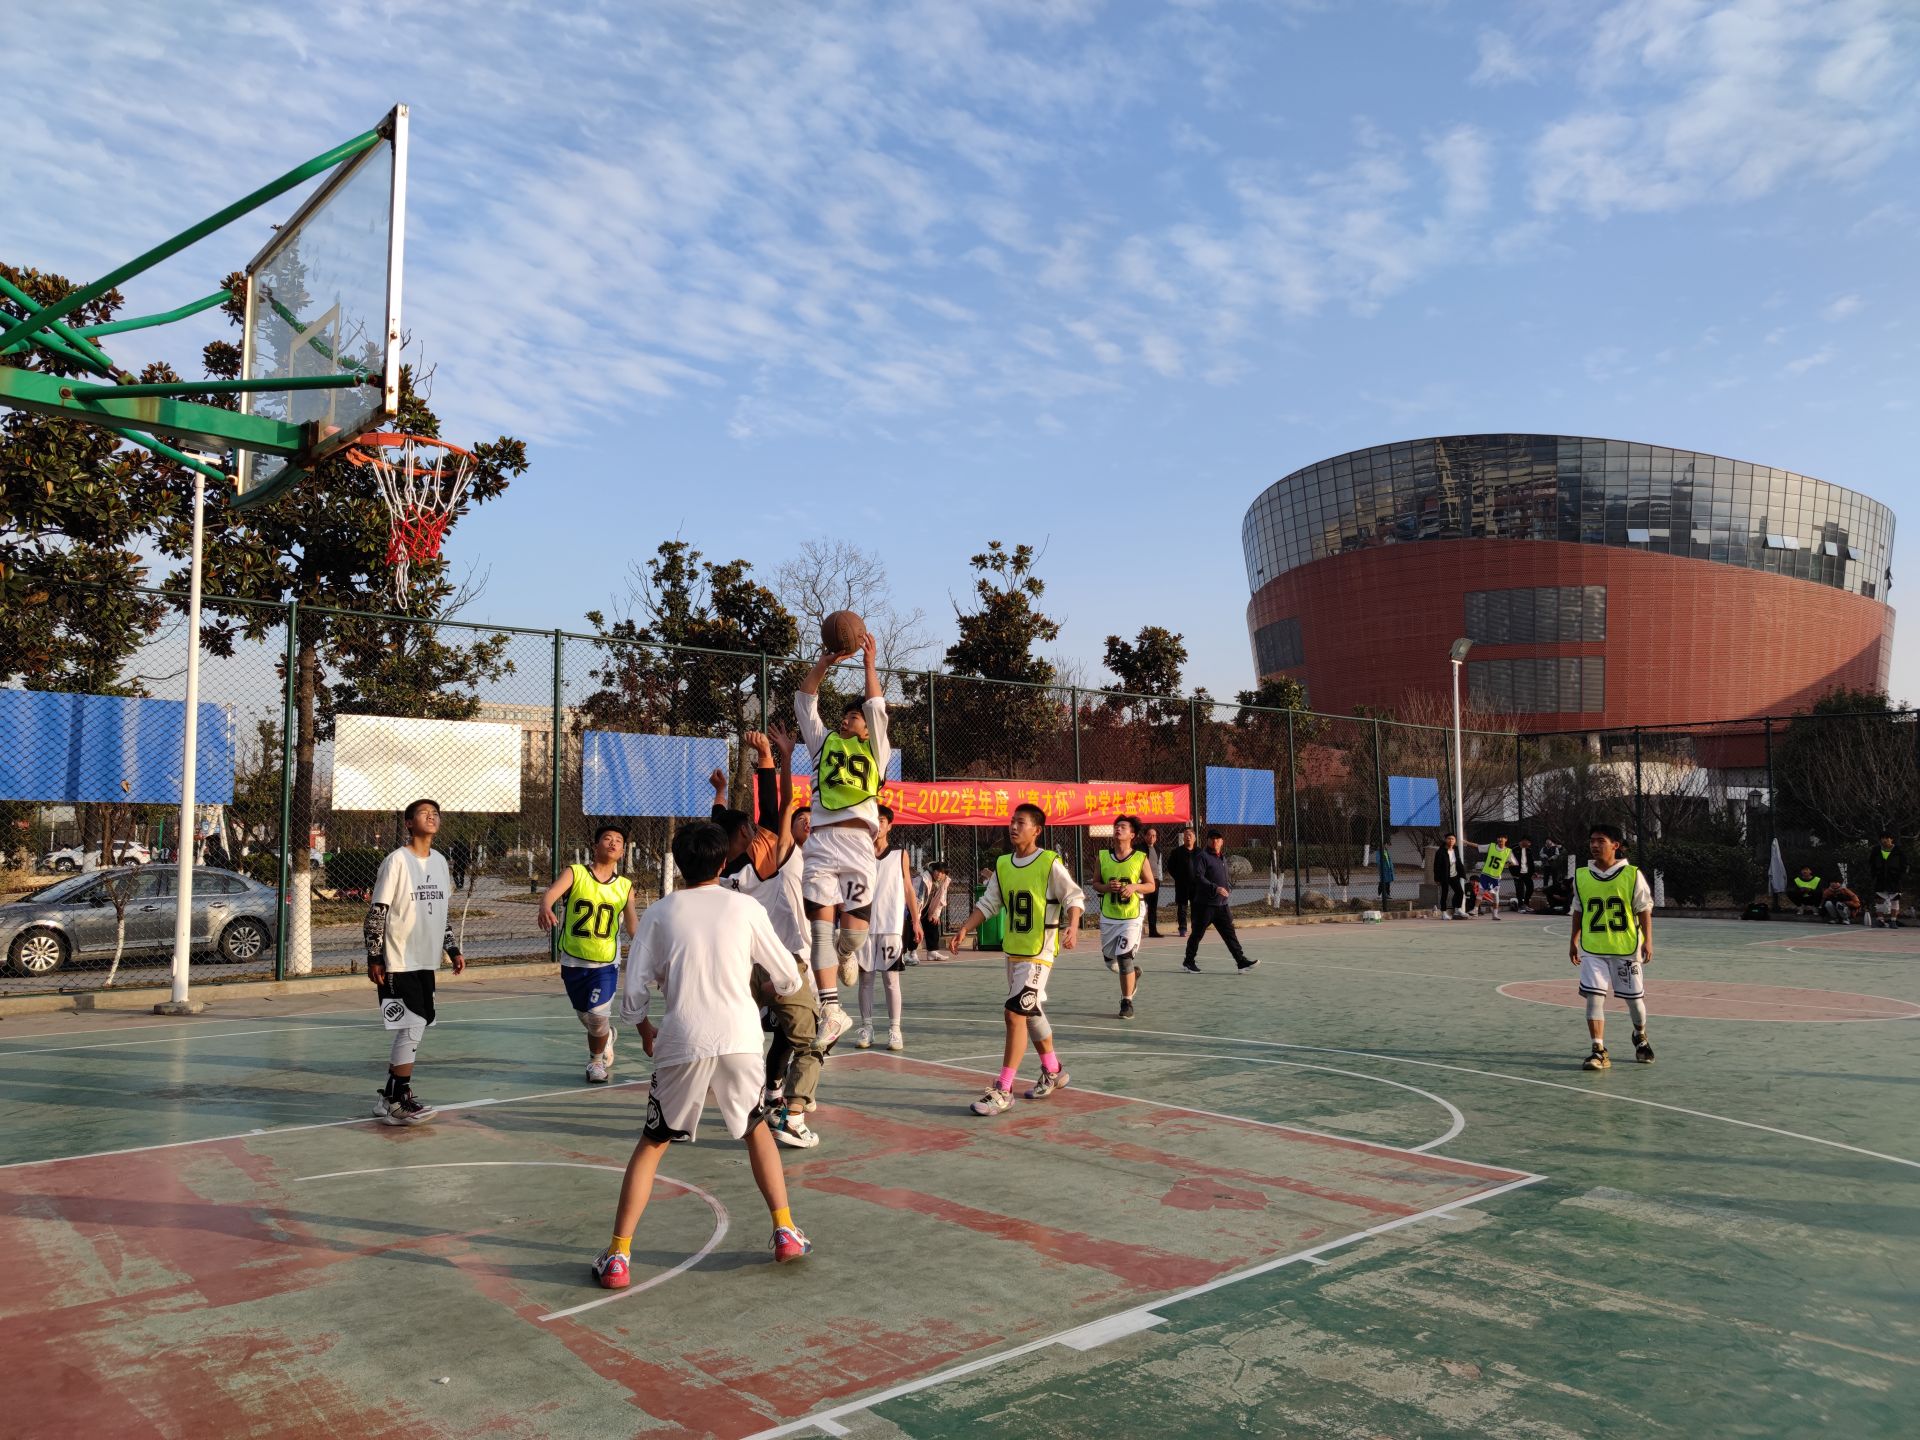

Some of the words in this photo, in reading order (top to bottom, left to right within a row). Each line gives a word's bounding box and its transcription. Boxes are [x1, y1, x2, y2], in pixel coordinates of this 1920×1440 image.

[825, 750, 871, 793] 29
[1488, 855, 1502, 870] 15
[410, 890, 444, 901] IVERSON
[846, 880, 866, 903] 12
[571, 898, 615, 939] 20
[1008, 889, 1034, 934] 19
[1587, 895, 1629, 933] 23
[881, 945, 896, 961] 12
